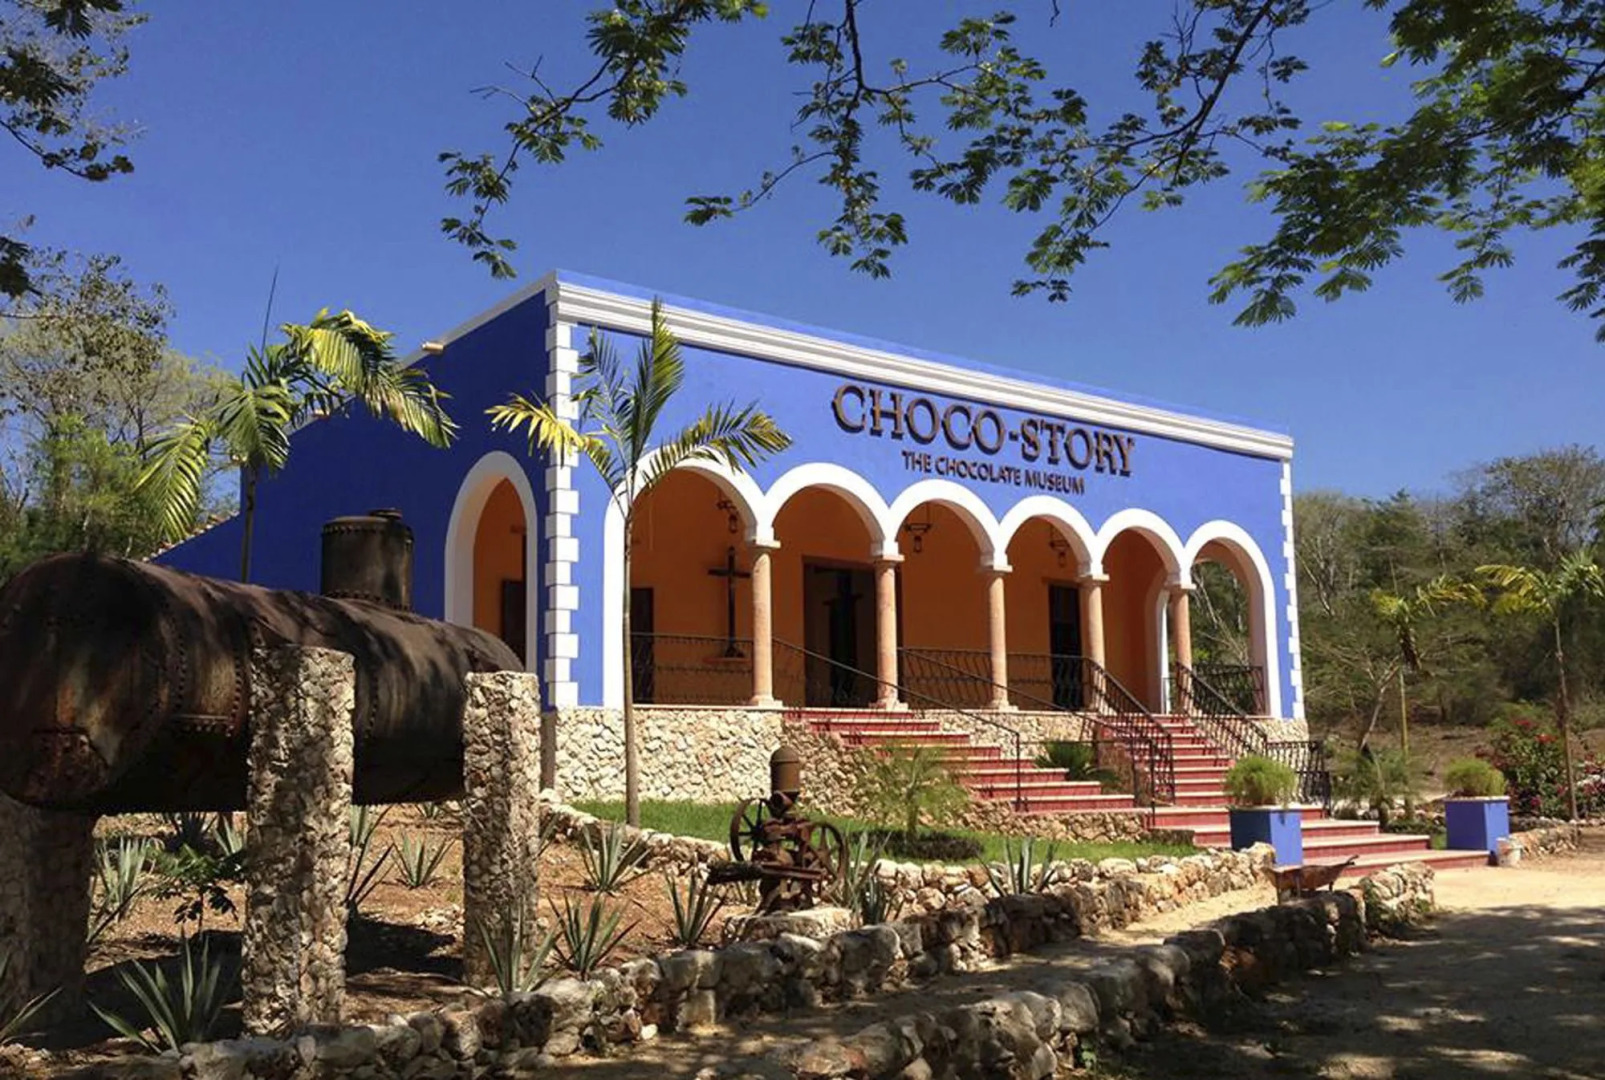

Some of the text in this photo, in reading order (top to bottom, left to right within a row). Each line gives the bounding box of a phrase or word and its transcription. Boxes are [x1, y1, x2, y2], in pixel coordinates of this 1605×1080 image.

[832, 384, 1135, 477] CHOCO-STORY
[902, 451, 1085, 495] THE CHOCOLATE MUSEUM
